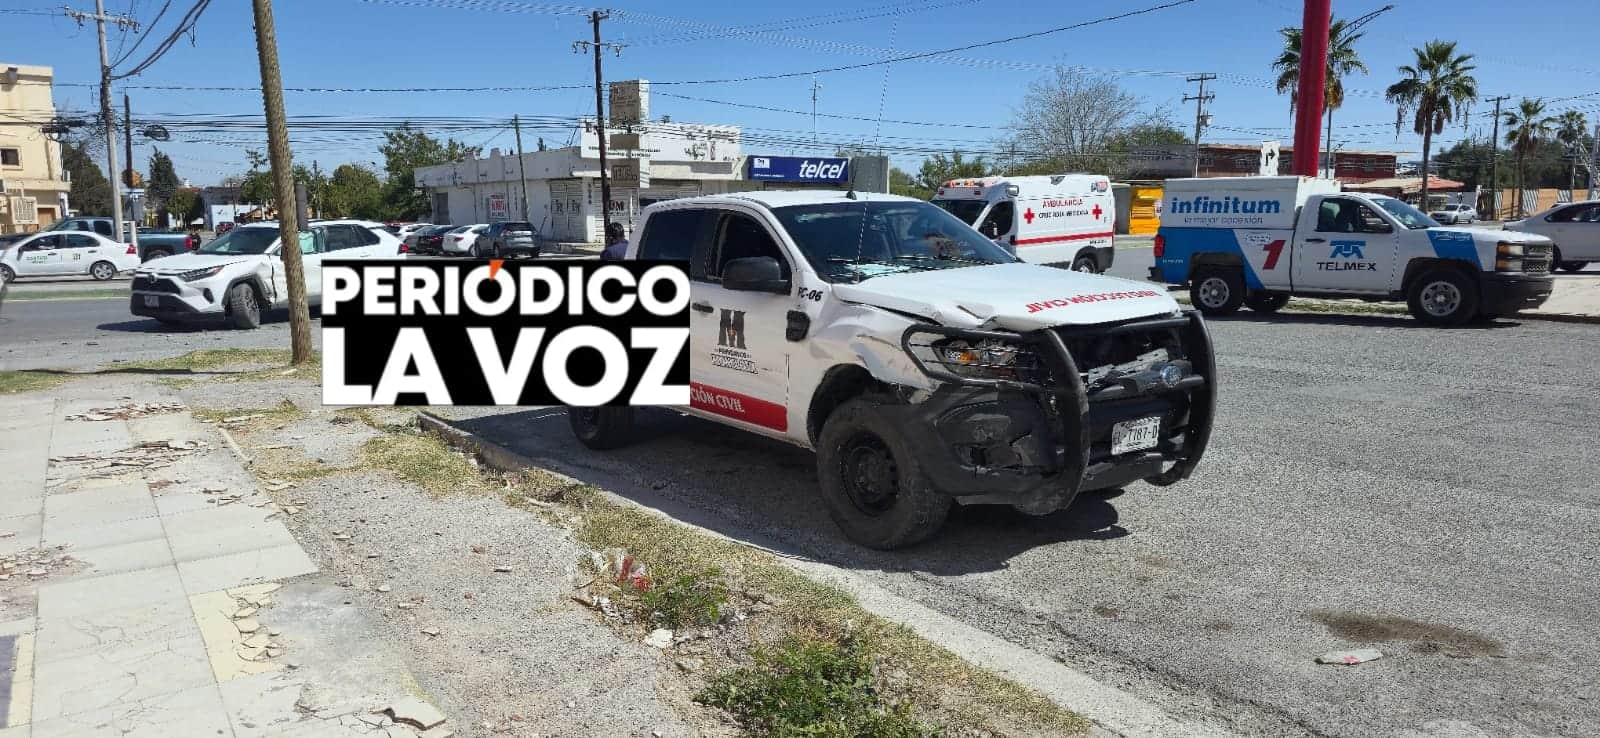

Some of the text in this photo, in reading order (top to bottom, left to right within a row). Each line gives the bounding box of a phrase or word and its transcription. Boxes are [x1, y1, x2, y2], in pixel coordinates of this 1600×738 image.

[799, 160, 846, 179] telcel
[1171, 196, 1280, 214] infinitum
[1262, 240, 1286, 270] 1
[1317, 262, 1377, 271] TELMEX
[715, 394, 745, 413] CIVIL
